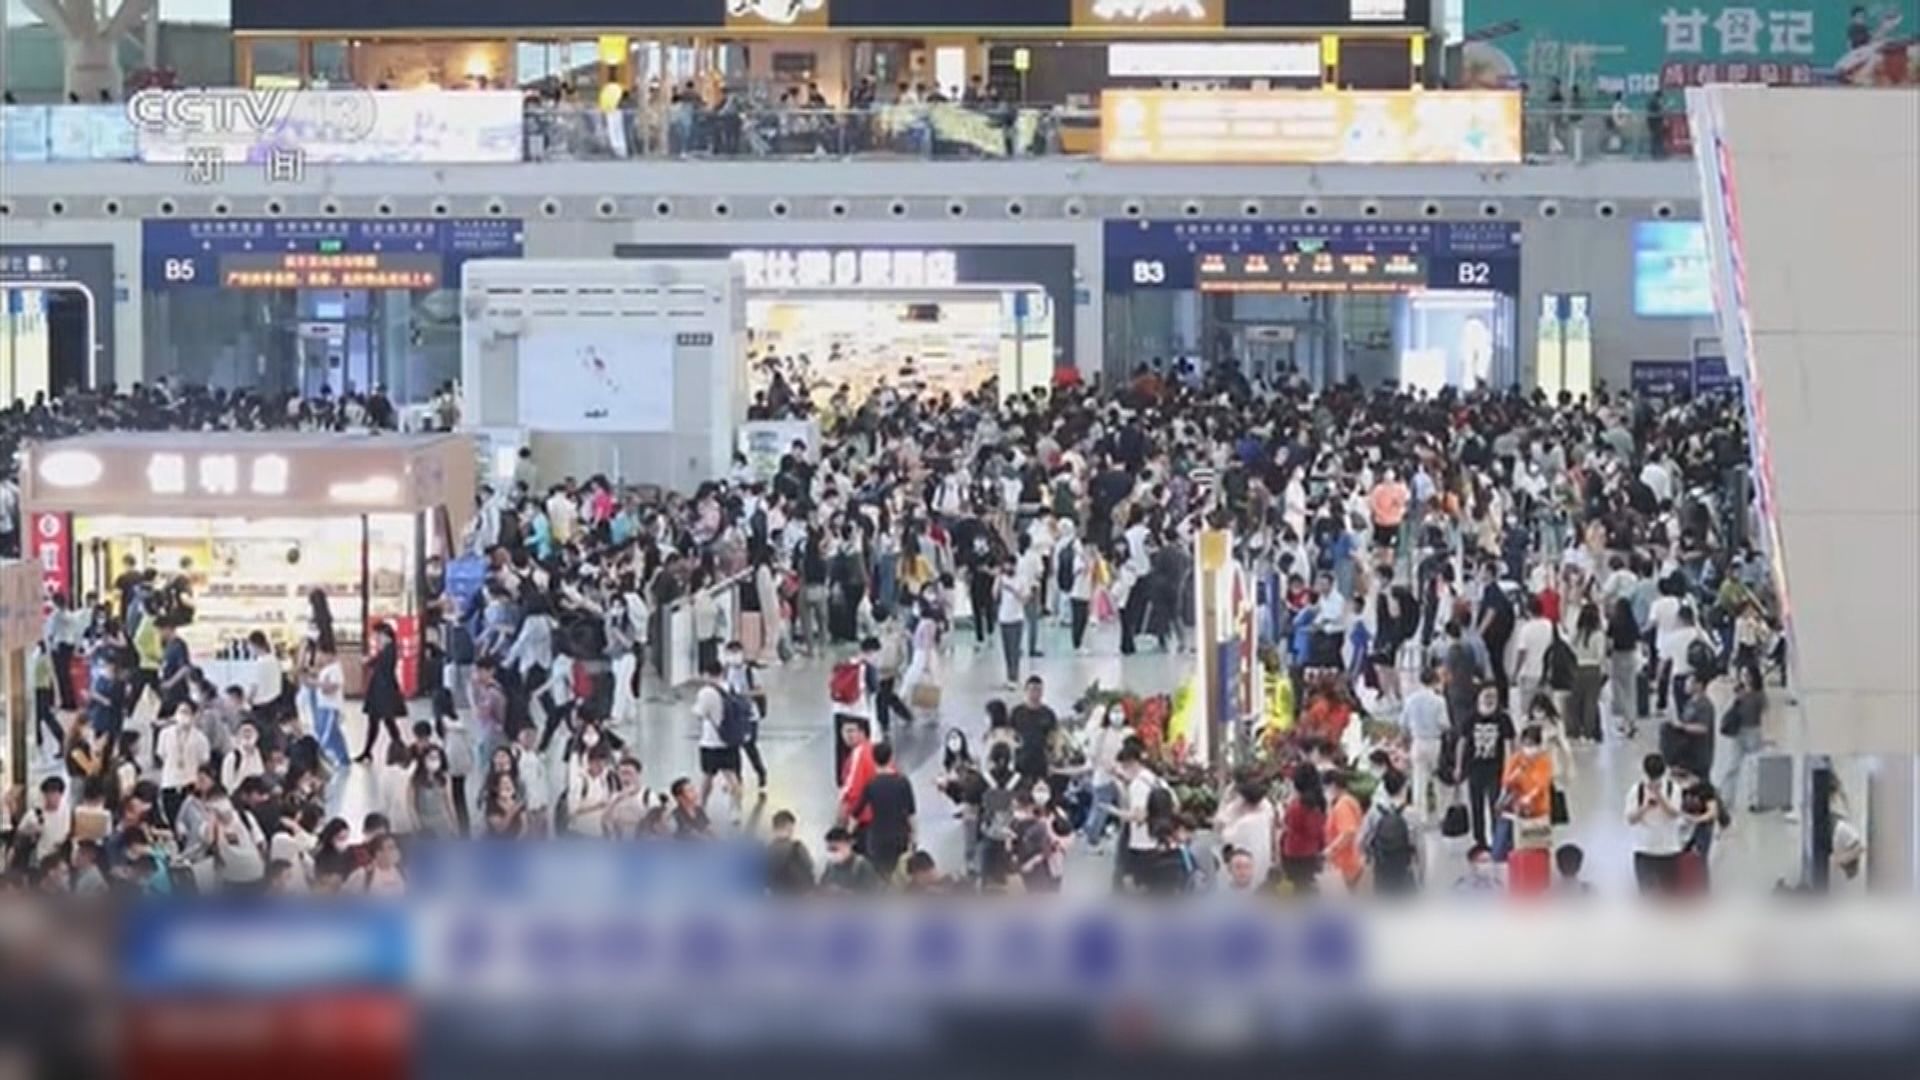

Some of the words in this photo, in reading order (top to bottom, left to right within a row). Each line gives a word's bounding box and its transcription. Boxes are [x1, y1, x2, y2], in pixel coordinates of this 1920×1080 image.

[165, 259, 195, 281] B5
[1133, 260, 1165, 284] B3
[1458, 262, 1490, 284] B2
